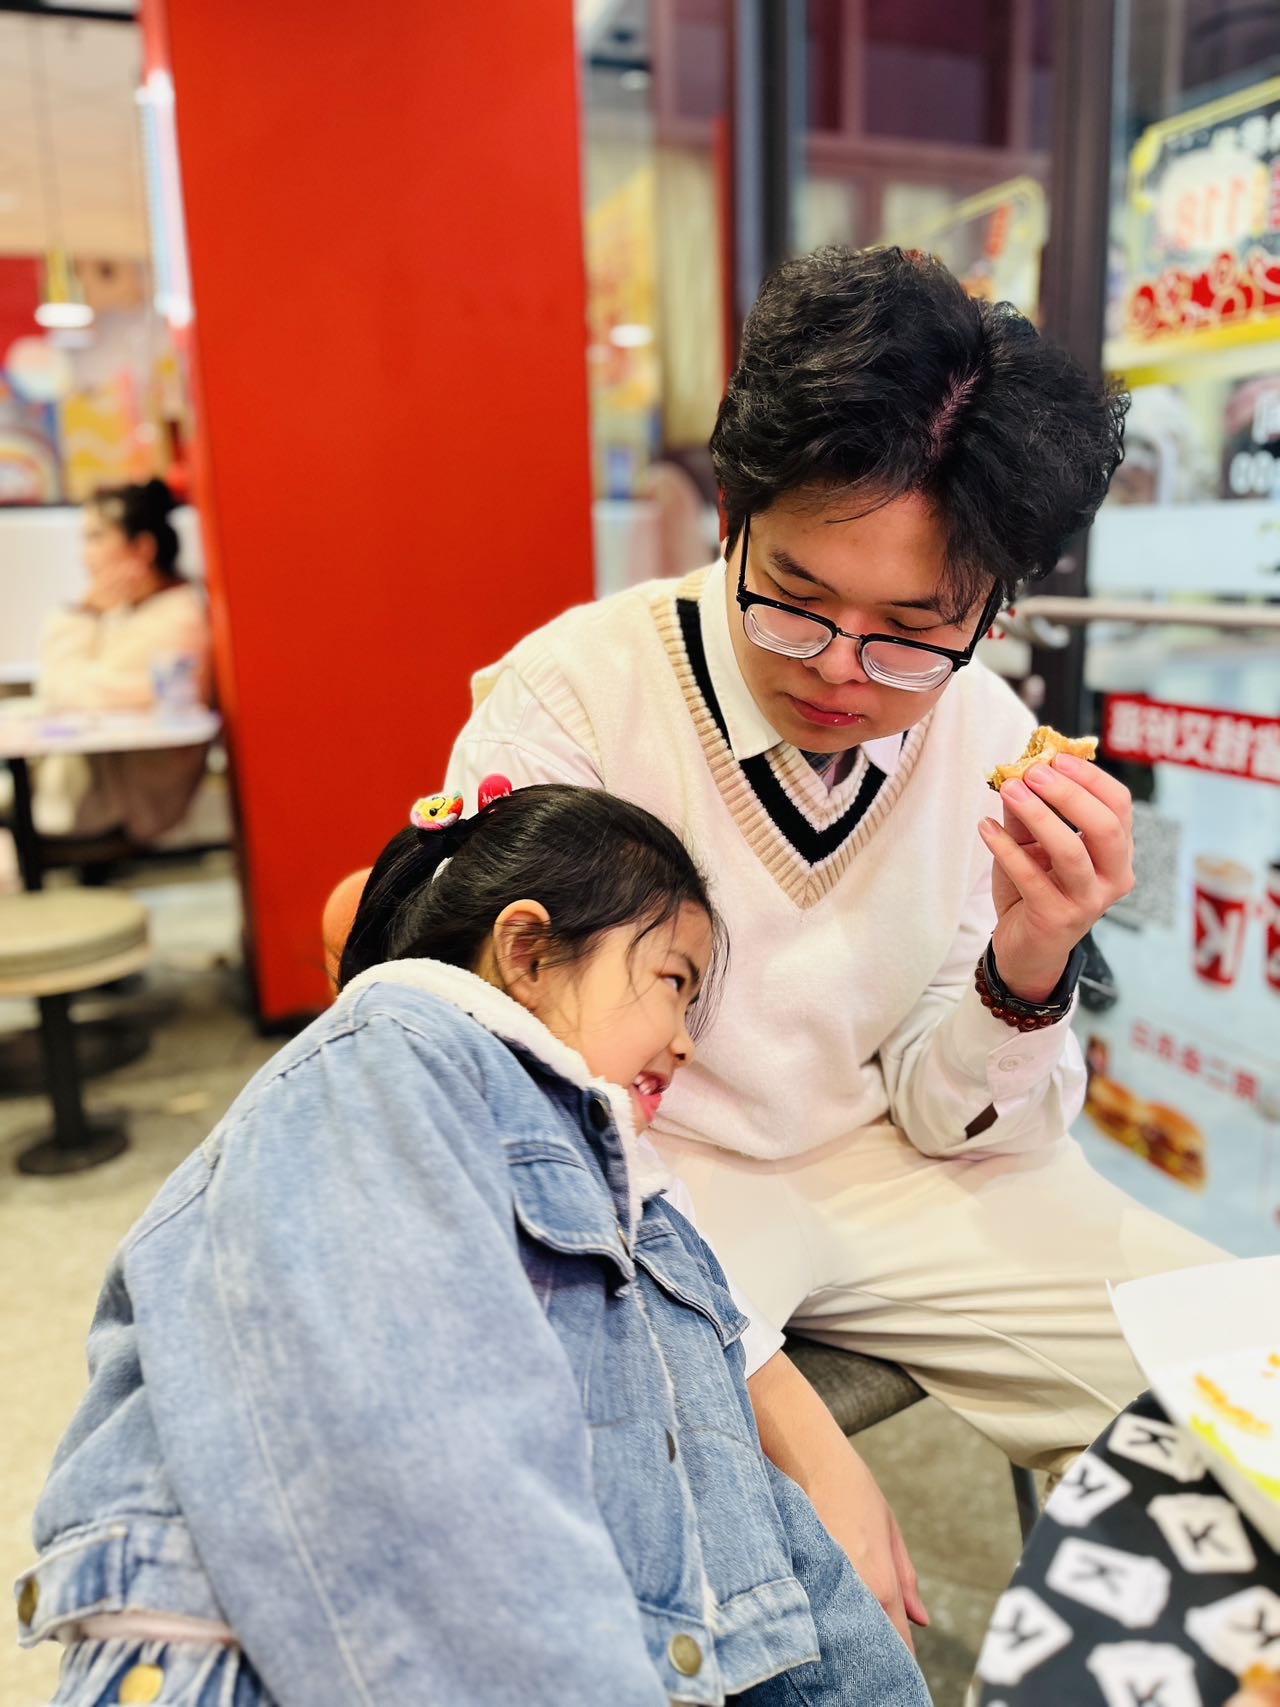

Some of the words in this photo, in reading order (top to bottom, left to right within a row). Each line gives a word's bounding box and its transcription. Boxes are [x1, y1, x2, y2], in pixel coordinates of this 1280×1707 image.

[1127, 1425, 1178, 1458] K
[1060, 1466, 1108, 1500] K
[1182, 1520, 1233, 1556] K
[1068, 1553, 1130, 1597] K
[990, 1608, 1044, 1650] K
